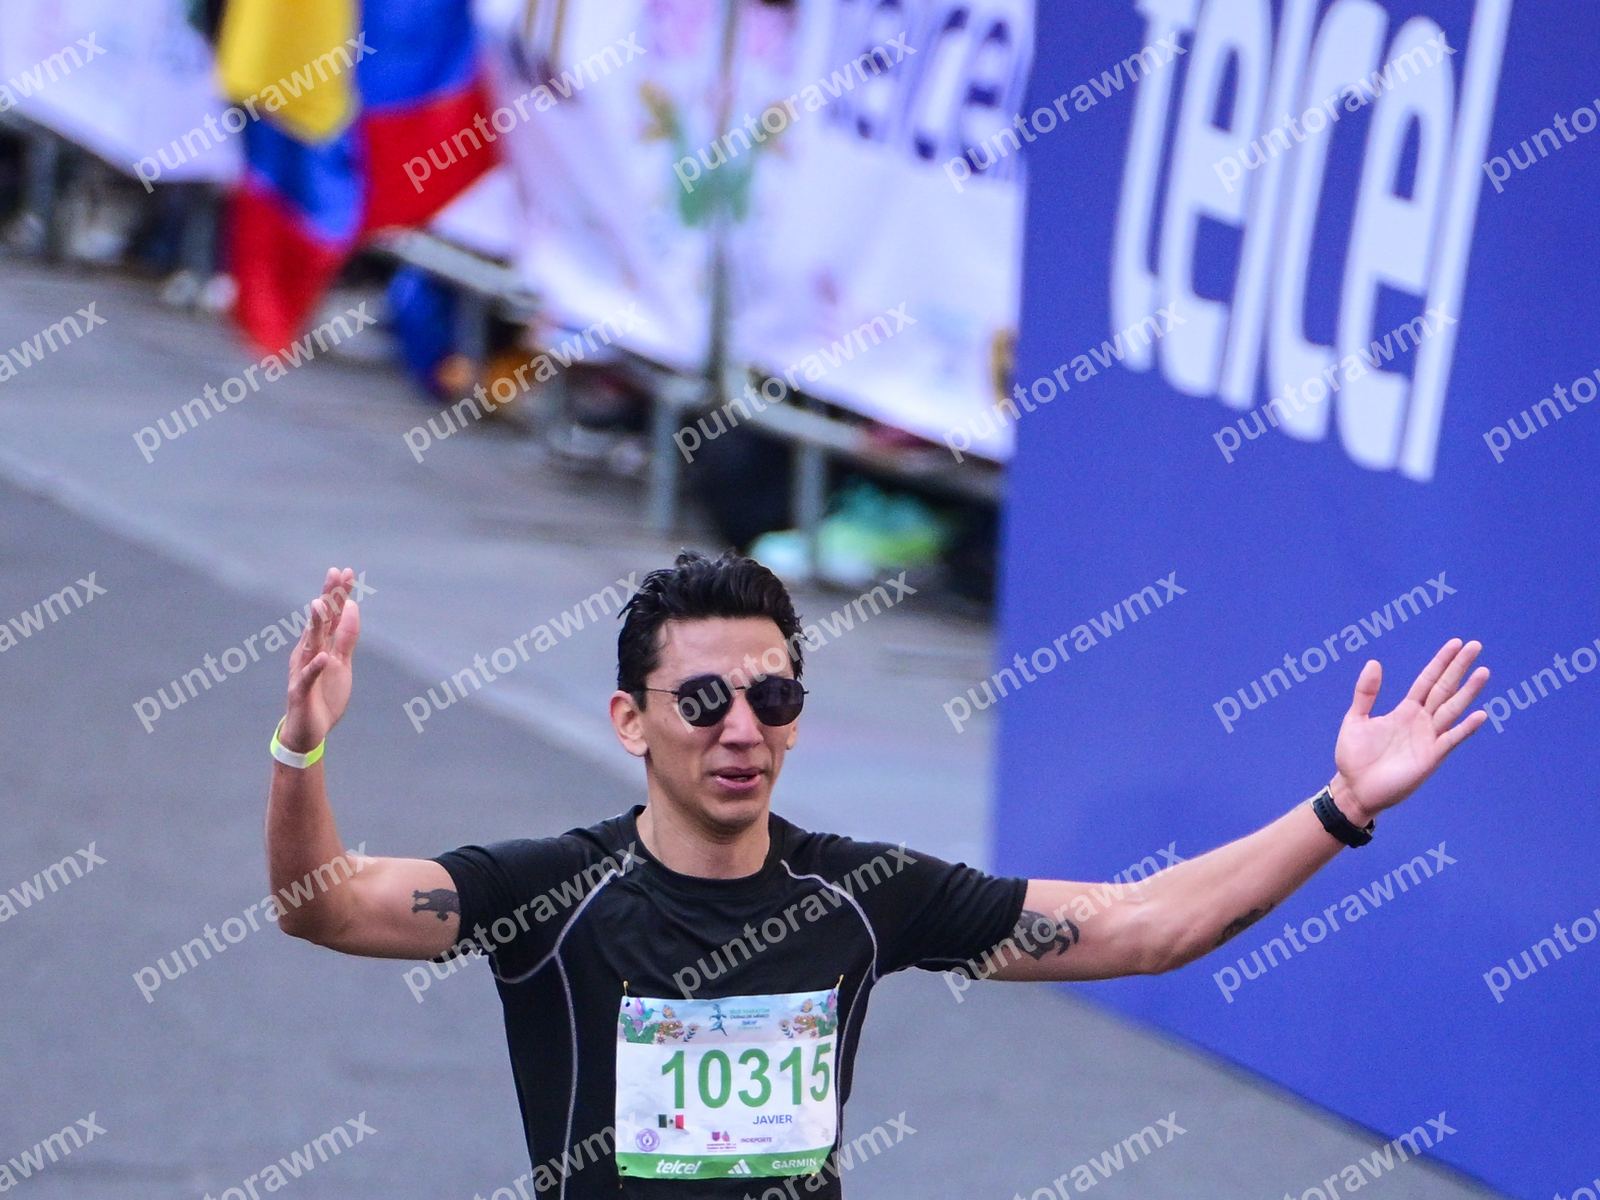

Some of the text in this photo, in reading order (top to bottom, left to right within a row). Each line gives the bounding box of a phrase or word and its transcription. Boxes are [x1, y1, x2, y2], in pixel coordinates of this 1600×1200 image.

[1110, 0, 1511, 482] telcel
[661, 1042, 832, 1109] 10315
[752, 1114, 793, 1125] JAVIER
[655, 1159, 702, 1175] telcel
[771, 1157, 817, 1170] GARMIN
